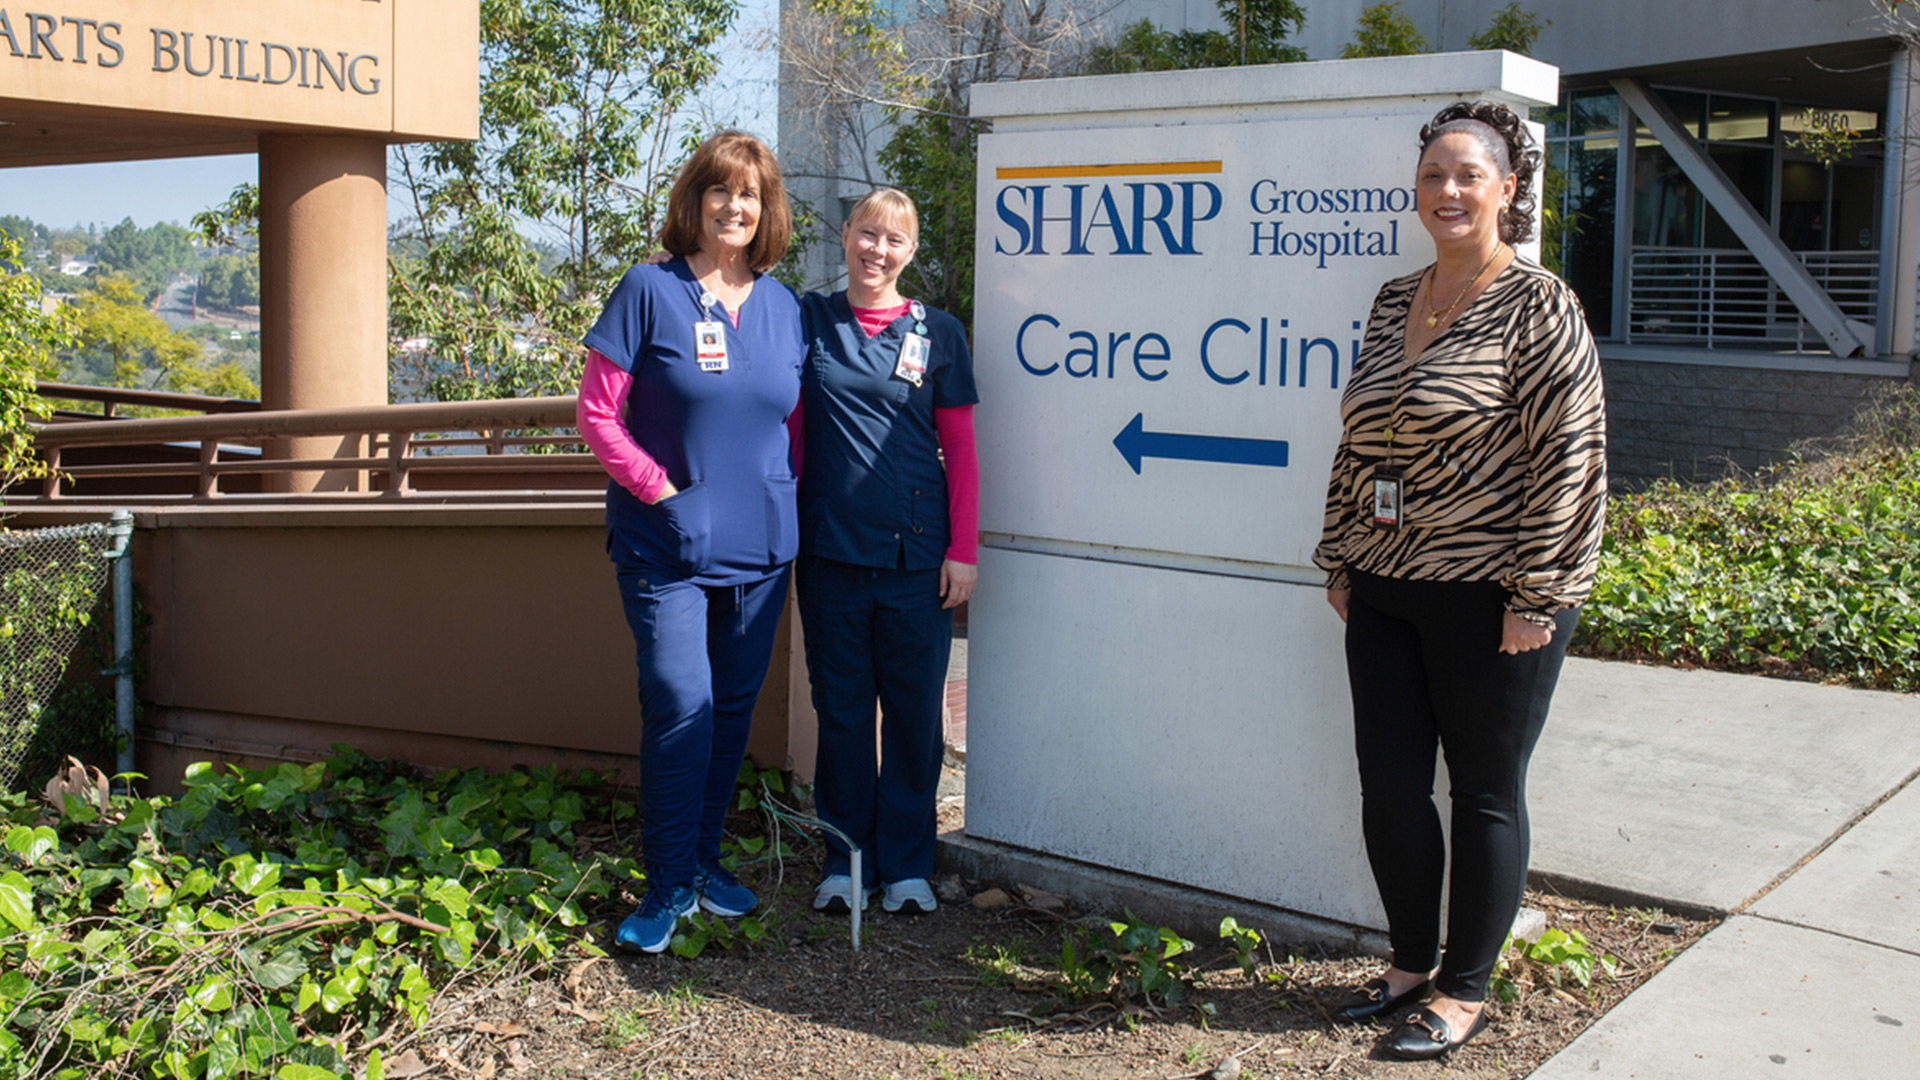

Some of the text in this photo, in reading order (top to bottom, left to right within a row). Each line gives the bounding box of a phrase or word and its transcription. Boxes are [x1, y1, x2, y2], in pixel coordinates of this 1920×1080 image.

[0, 8, 381, 95] ARTS BUILDING
[1811, 111, 1849, 131] 8860
[994, 180, 1223, 256] SHARP
[1250, 179, 1418, 214] Grossmo
[1249, 219, 1400, 269] Hospital
[1016, 313, 1361, 389] Care Clini
